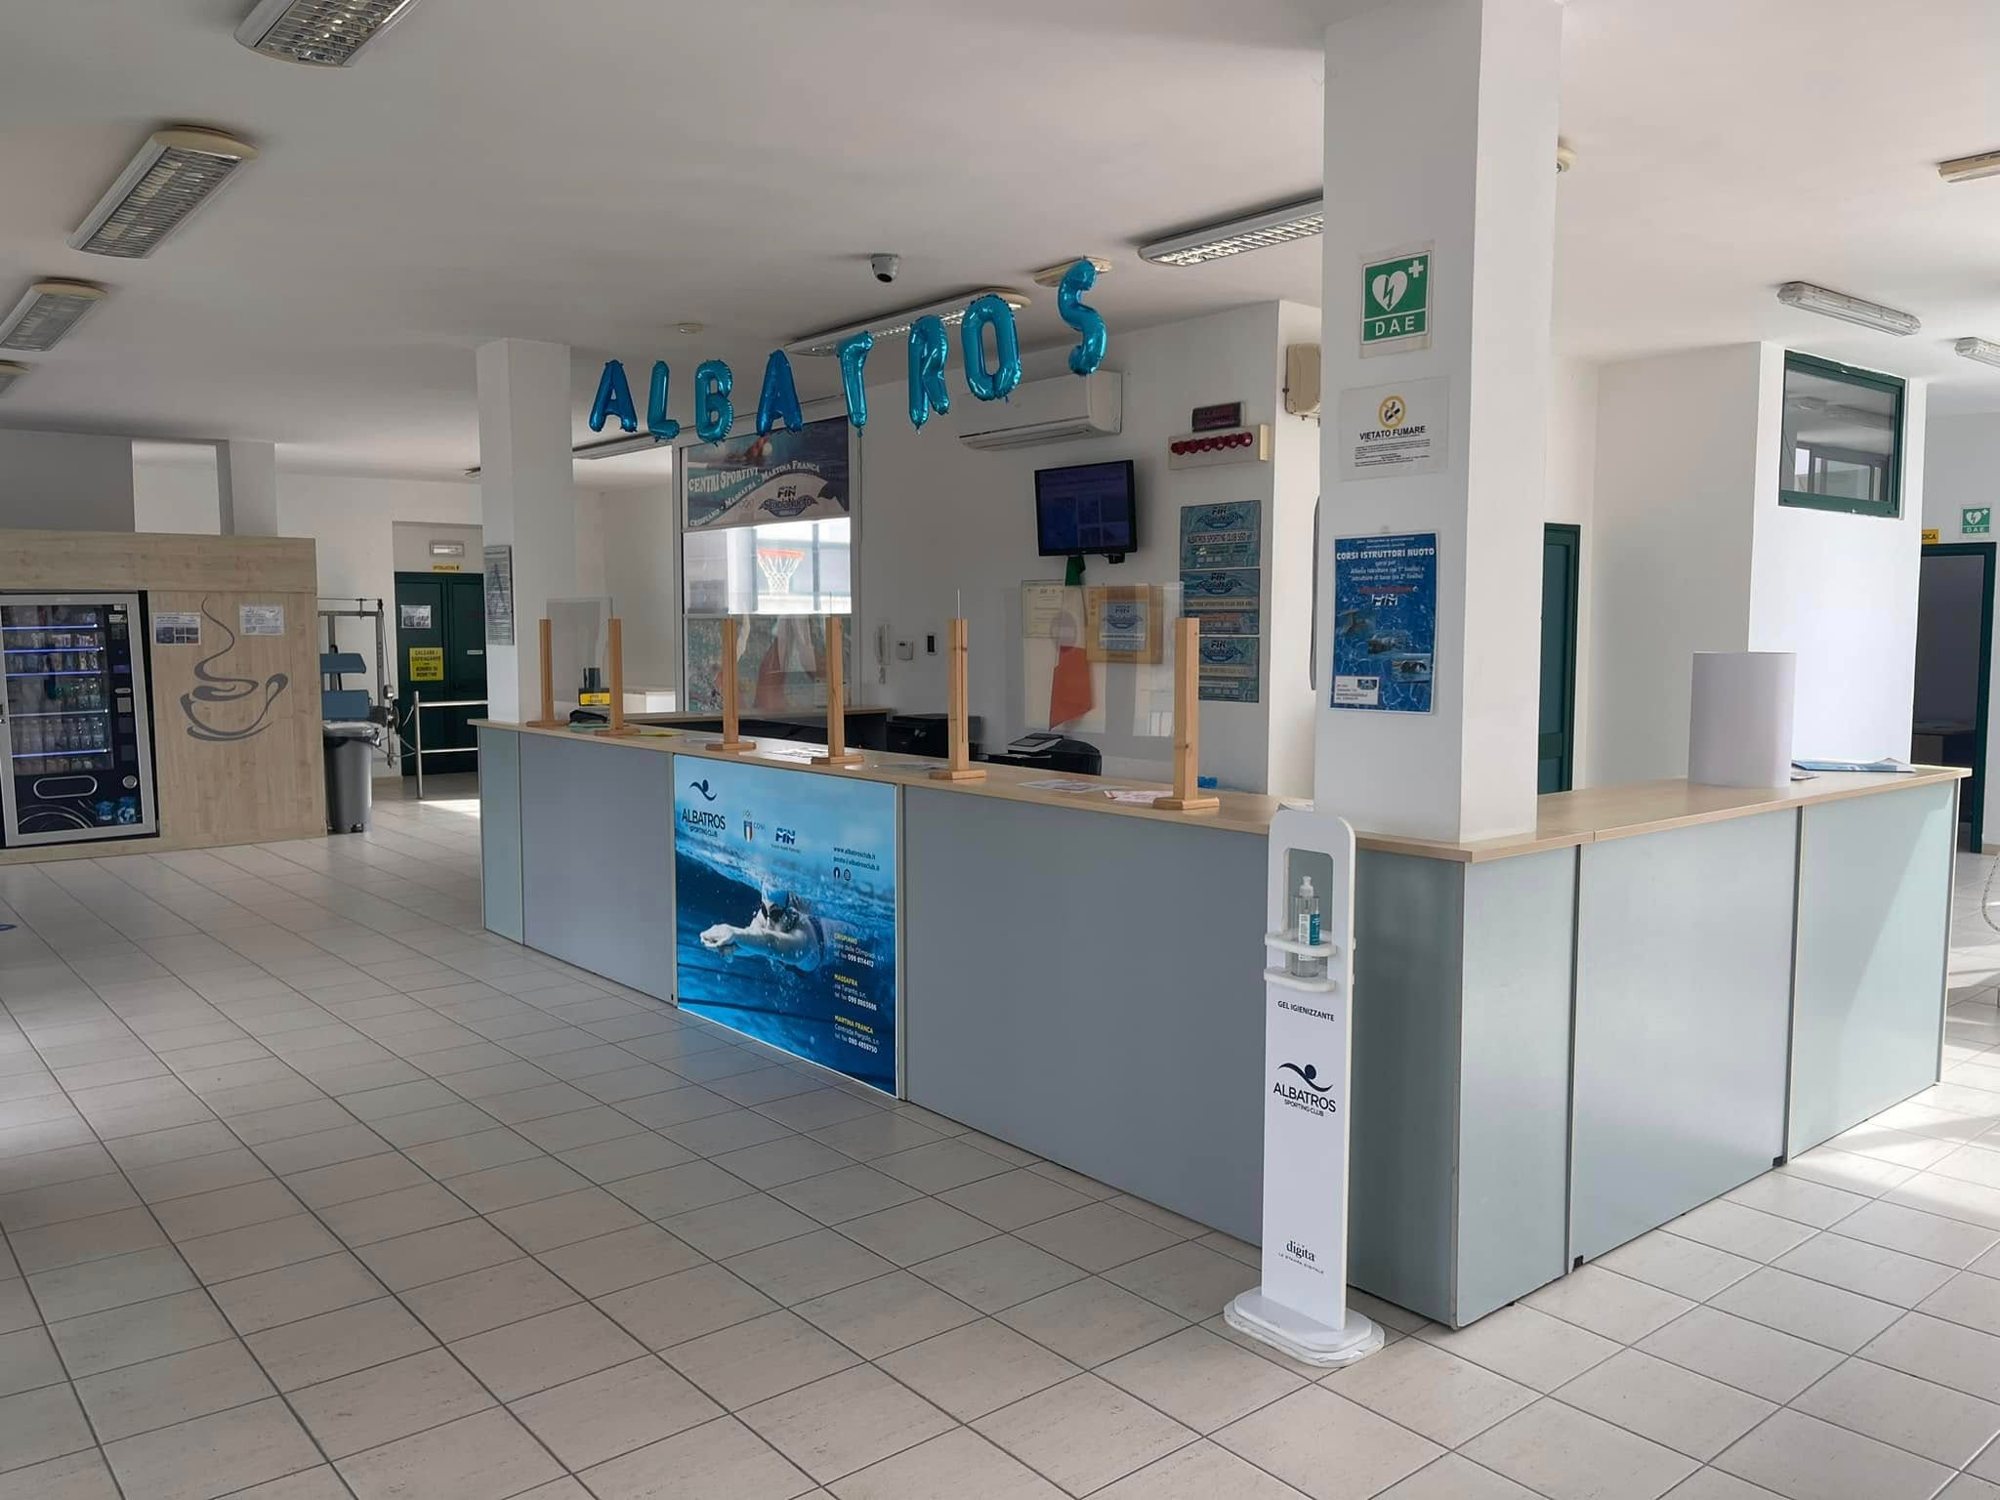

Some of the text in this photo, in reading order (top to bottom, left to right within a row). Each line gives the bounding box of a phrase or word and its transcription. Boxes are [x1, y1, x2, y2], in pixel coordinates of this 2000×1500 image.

[1375, 315, 1415, 336] DAE
[1360, 429, 1391, 441] VIETATO
[1392, 425, 1427, 437] FUMARE
[688, 467, 759, 493] CENTRI SPORTIVI
[1337, 547, 1435, 560] CORSI ISTRUTTORI NUOTO
[681, 807, 726, 831] ALBATROS
[1277, 1000, 1335, 1022] GEL IGIENIZZANTE
[1273, 1082, 1337, 1113] ALBATROS
[1284, 1098, 1324, 1117] SPORTING CLUB
[1286, 1240, 1315, 1262] digita
